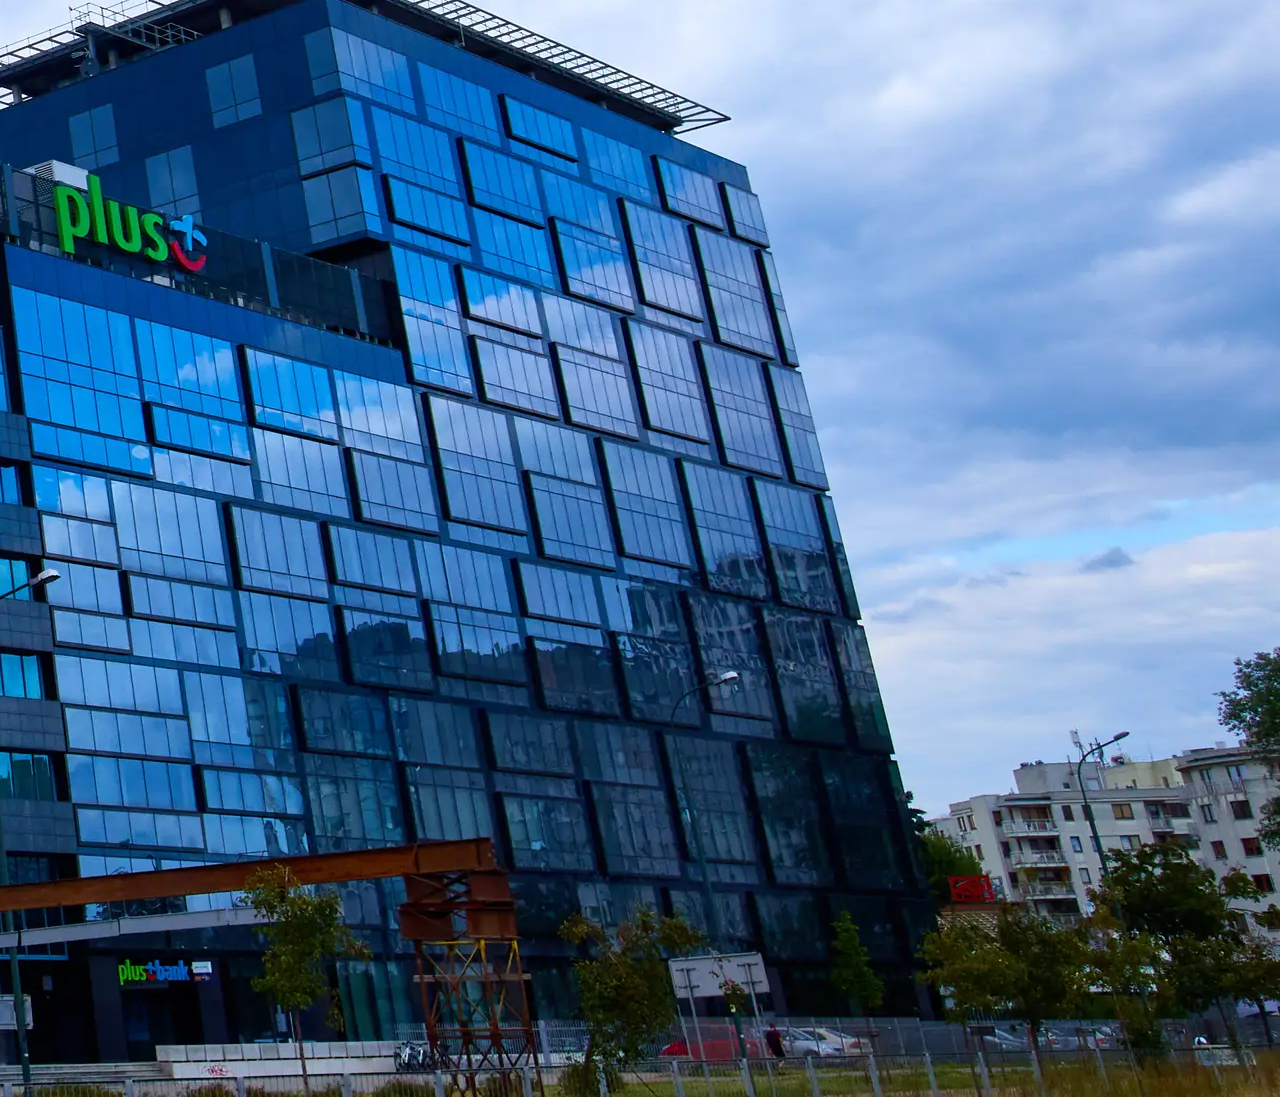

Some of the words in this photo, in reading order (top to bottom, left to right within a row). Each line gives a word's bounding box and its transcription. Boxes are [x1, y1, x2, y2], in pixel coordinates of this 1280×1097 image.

[53, 174, 169, 262] plus
[118, 959, 147, 985] plus
[153, 959, 191, 981] bank
